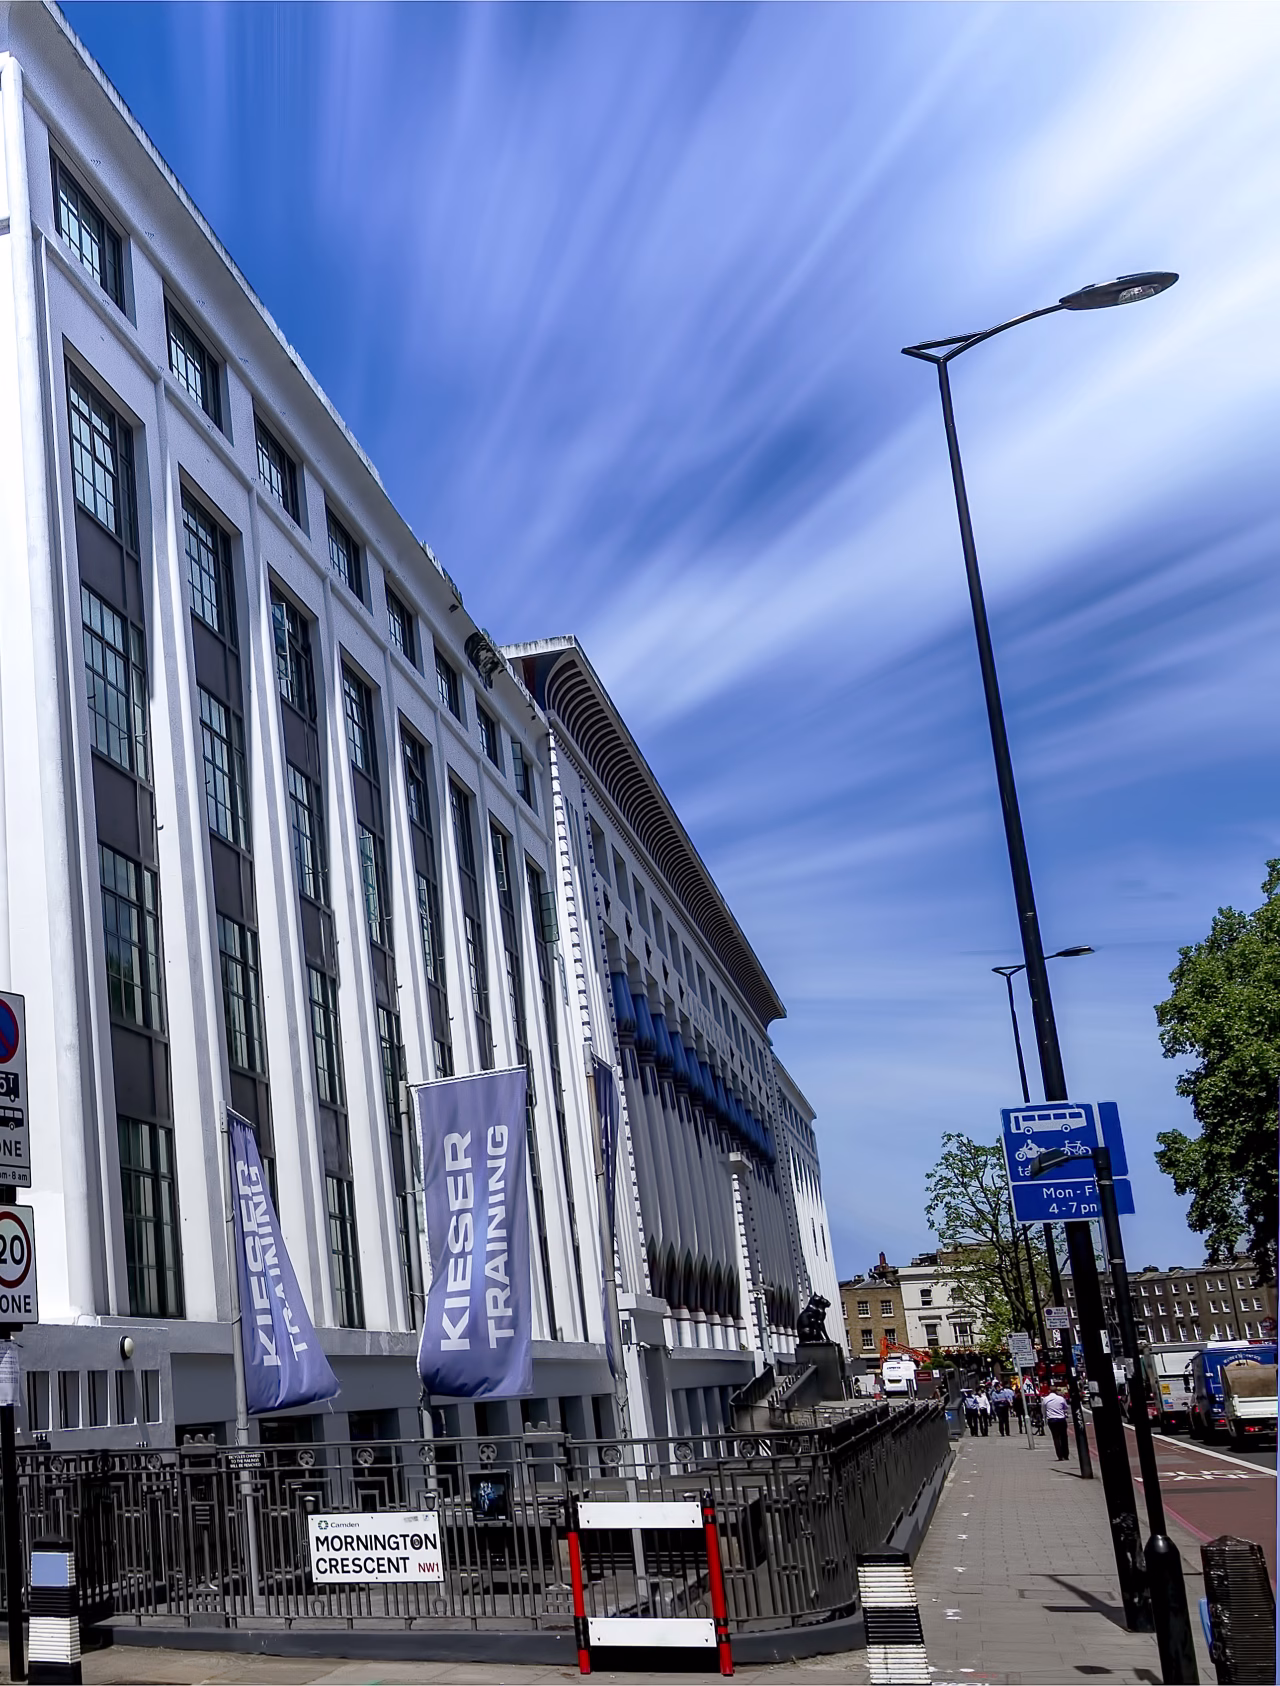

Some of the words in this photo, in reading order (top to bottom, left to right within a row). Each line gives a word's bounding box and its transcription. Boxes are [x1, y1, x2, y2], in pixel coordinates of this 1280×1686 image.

[17, 1173, 28, 1182] am
[1042, 1187, 1074, 1199] Mon
[1048, 1202, 1059, 1214] 4
[1068, 1201, 1077, 1214] 7
[441, 1130, 474, 1352] KIESER
[485, 1124, 515, 1349] TRAINING
[236, 1160, 282, 1367] KIESER
[330, 1521, 360, 1529] Camden
[315, 1533, 438, 1552] MORNINGTON
[315, 1556, 410, 1575] CRESCENT
[417, 1562, 440, 1573] NW1
